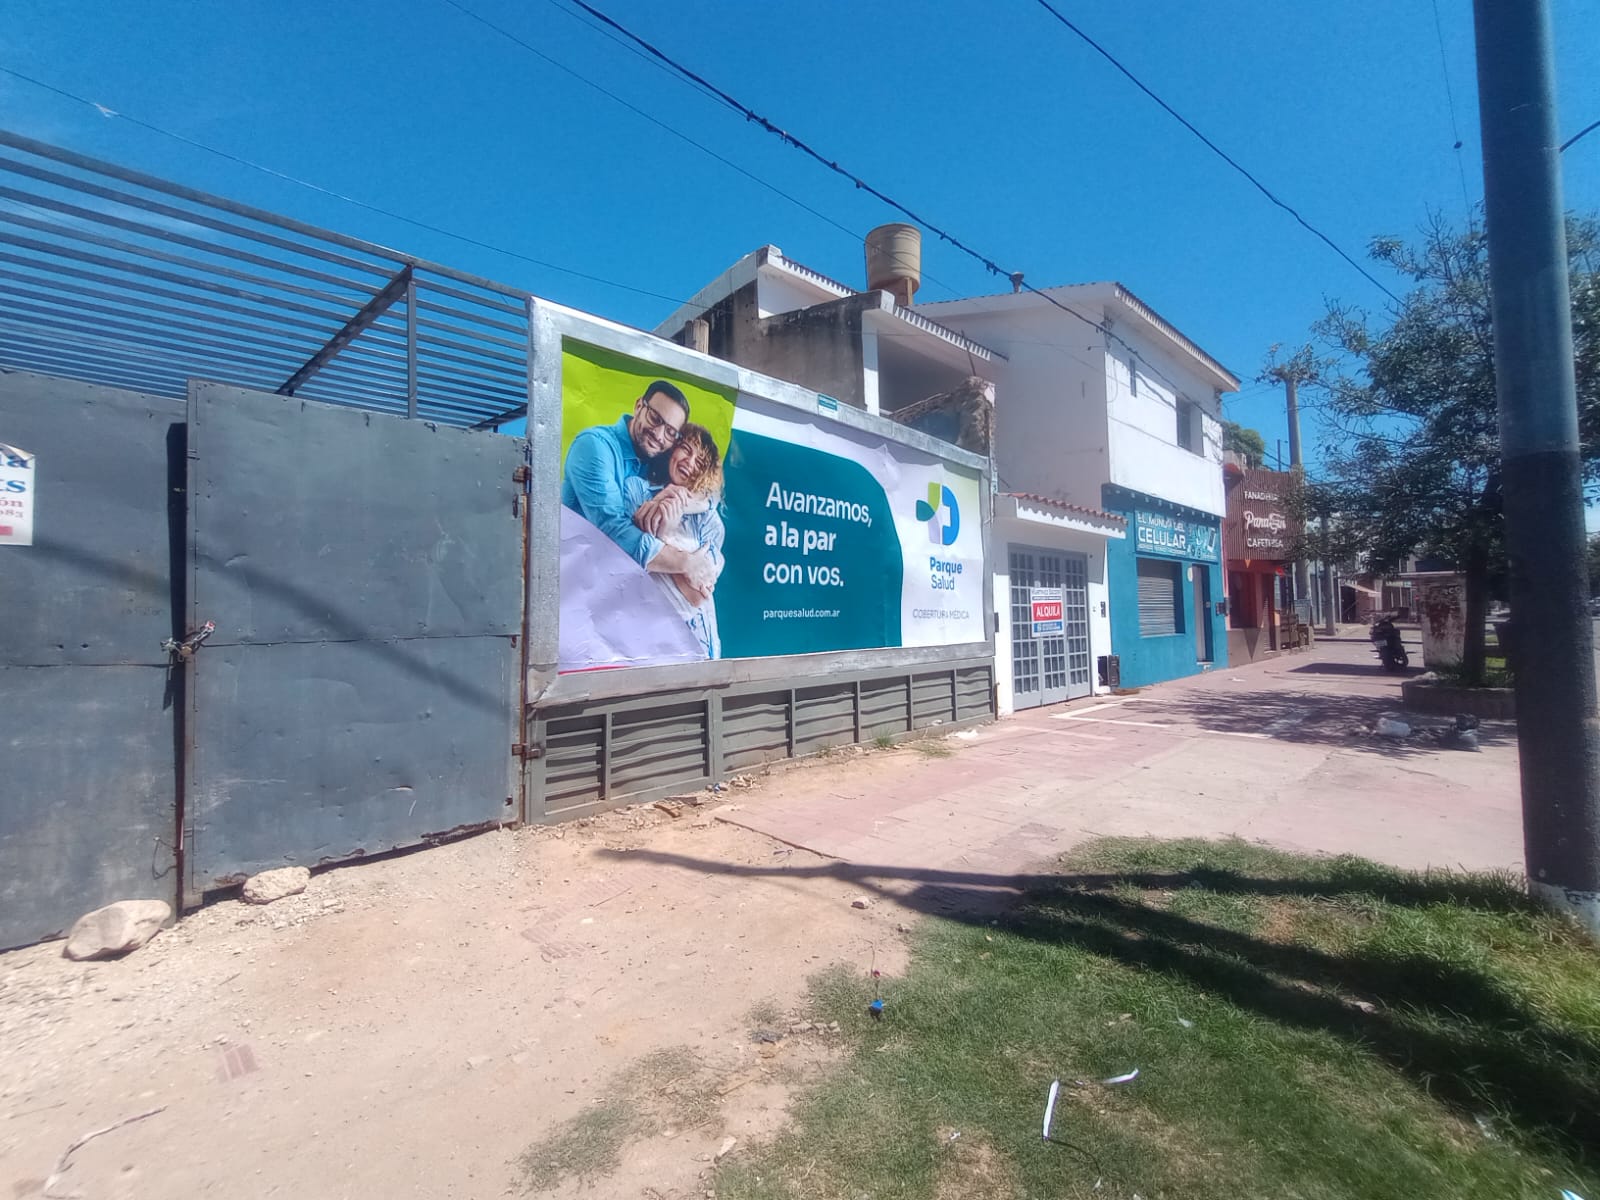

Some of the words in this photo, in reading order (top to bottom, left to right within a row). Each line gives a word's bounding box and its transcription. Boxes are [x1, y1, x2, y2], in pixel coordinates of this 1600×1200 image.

[765, 481, 872, 528] Avanzamos,
[764, 524, 777, 546] a
[780, 520, 799, 548] la
[802, 529, 837, 555] par
[1138, 526, 1186, 550] CELULAR
[763, 562, 803, 585] con
[807, 566, 844, 587] vos.
[929, 556, 963, 576] Parque
[930, 573, 955, 591] Salud
[763, 607, 841, 621] parquesalud.com.ar
[1036, 605, 1061, 618] ALQUILA
